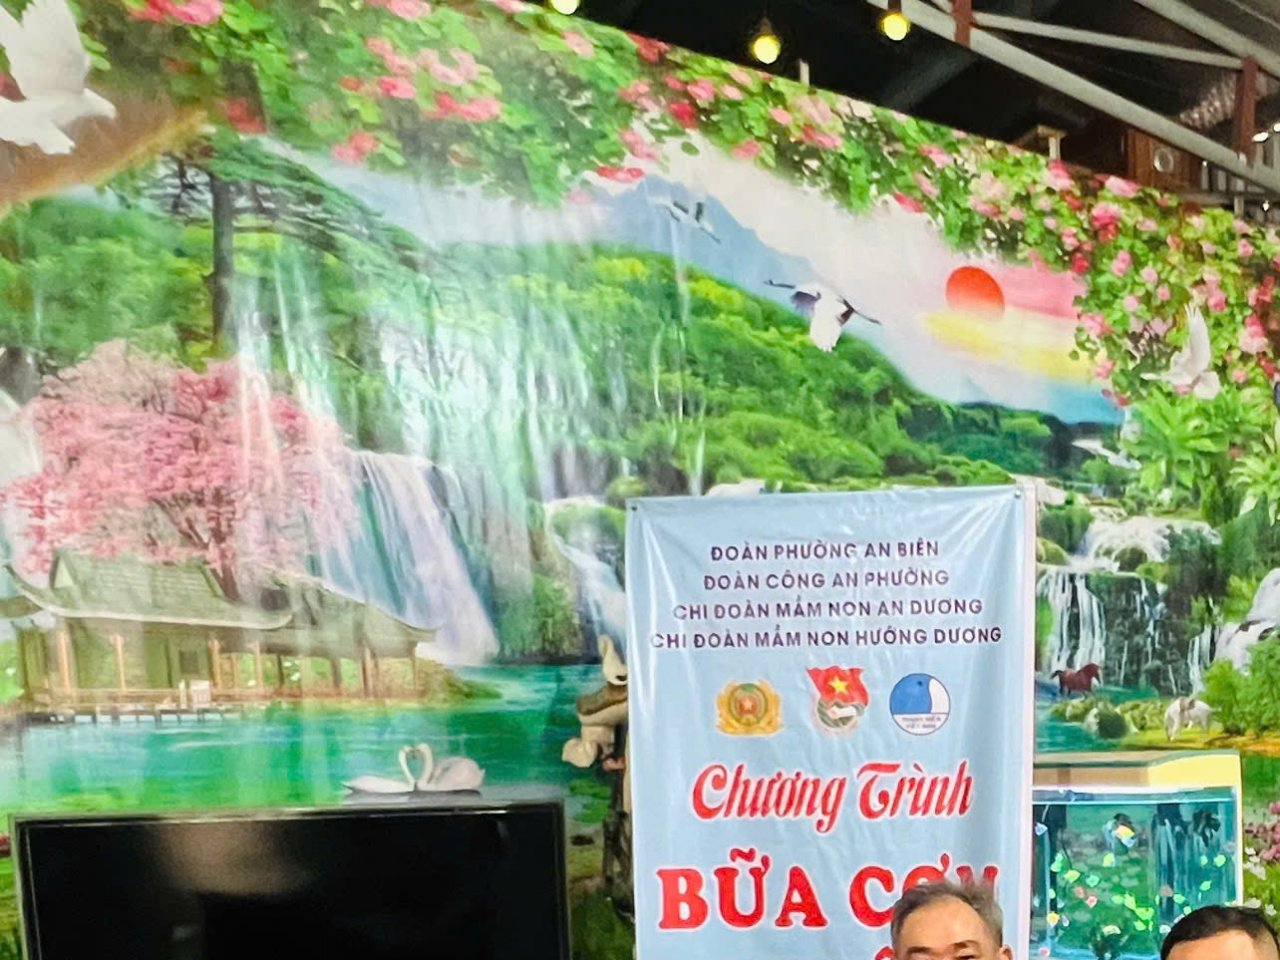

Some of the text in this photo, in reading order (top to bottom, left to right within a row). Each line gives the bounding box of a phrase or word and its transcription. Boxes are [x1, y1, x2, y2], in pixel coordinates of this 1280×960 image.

[710, 537, 939, 561] ĐOÀN PHƯỜNG AN BIÊN
[704, 566, 950, 590] ĐOÀN CÔNG AN PHƯỜNG
[672, 604, 708, 621] CHI
[714, 600, 770, 619] ĐOÀN
[829, 600, 871, 617] NON
[877, 599, 904, 616] AN
[910, 598, 983, 615] DƯƠNG
[651, 633, 688, 649] CHI
[694, 629, 749, 648] ĐOÀN
[808, 630, 850, 647] NON
[856, 626, 928, 646] HƯỚNG
[934, 626, 1002, 644] DƯƠNG
[693, 758, 974, 834] Chương Trình
[657, 848, 828, 929] BỮA
